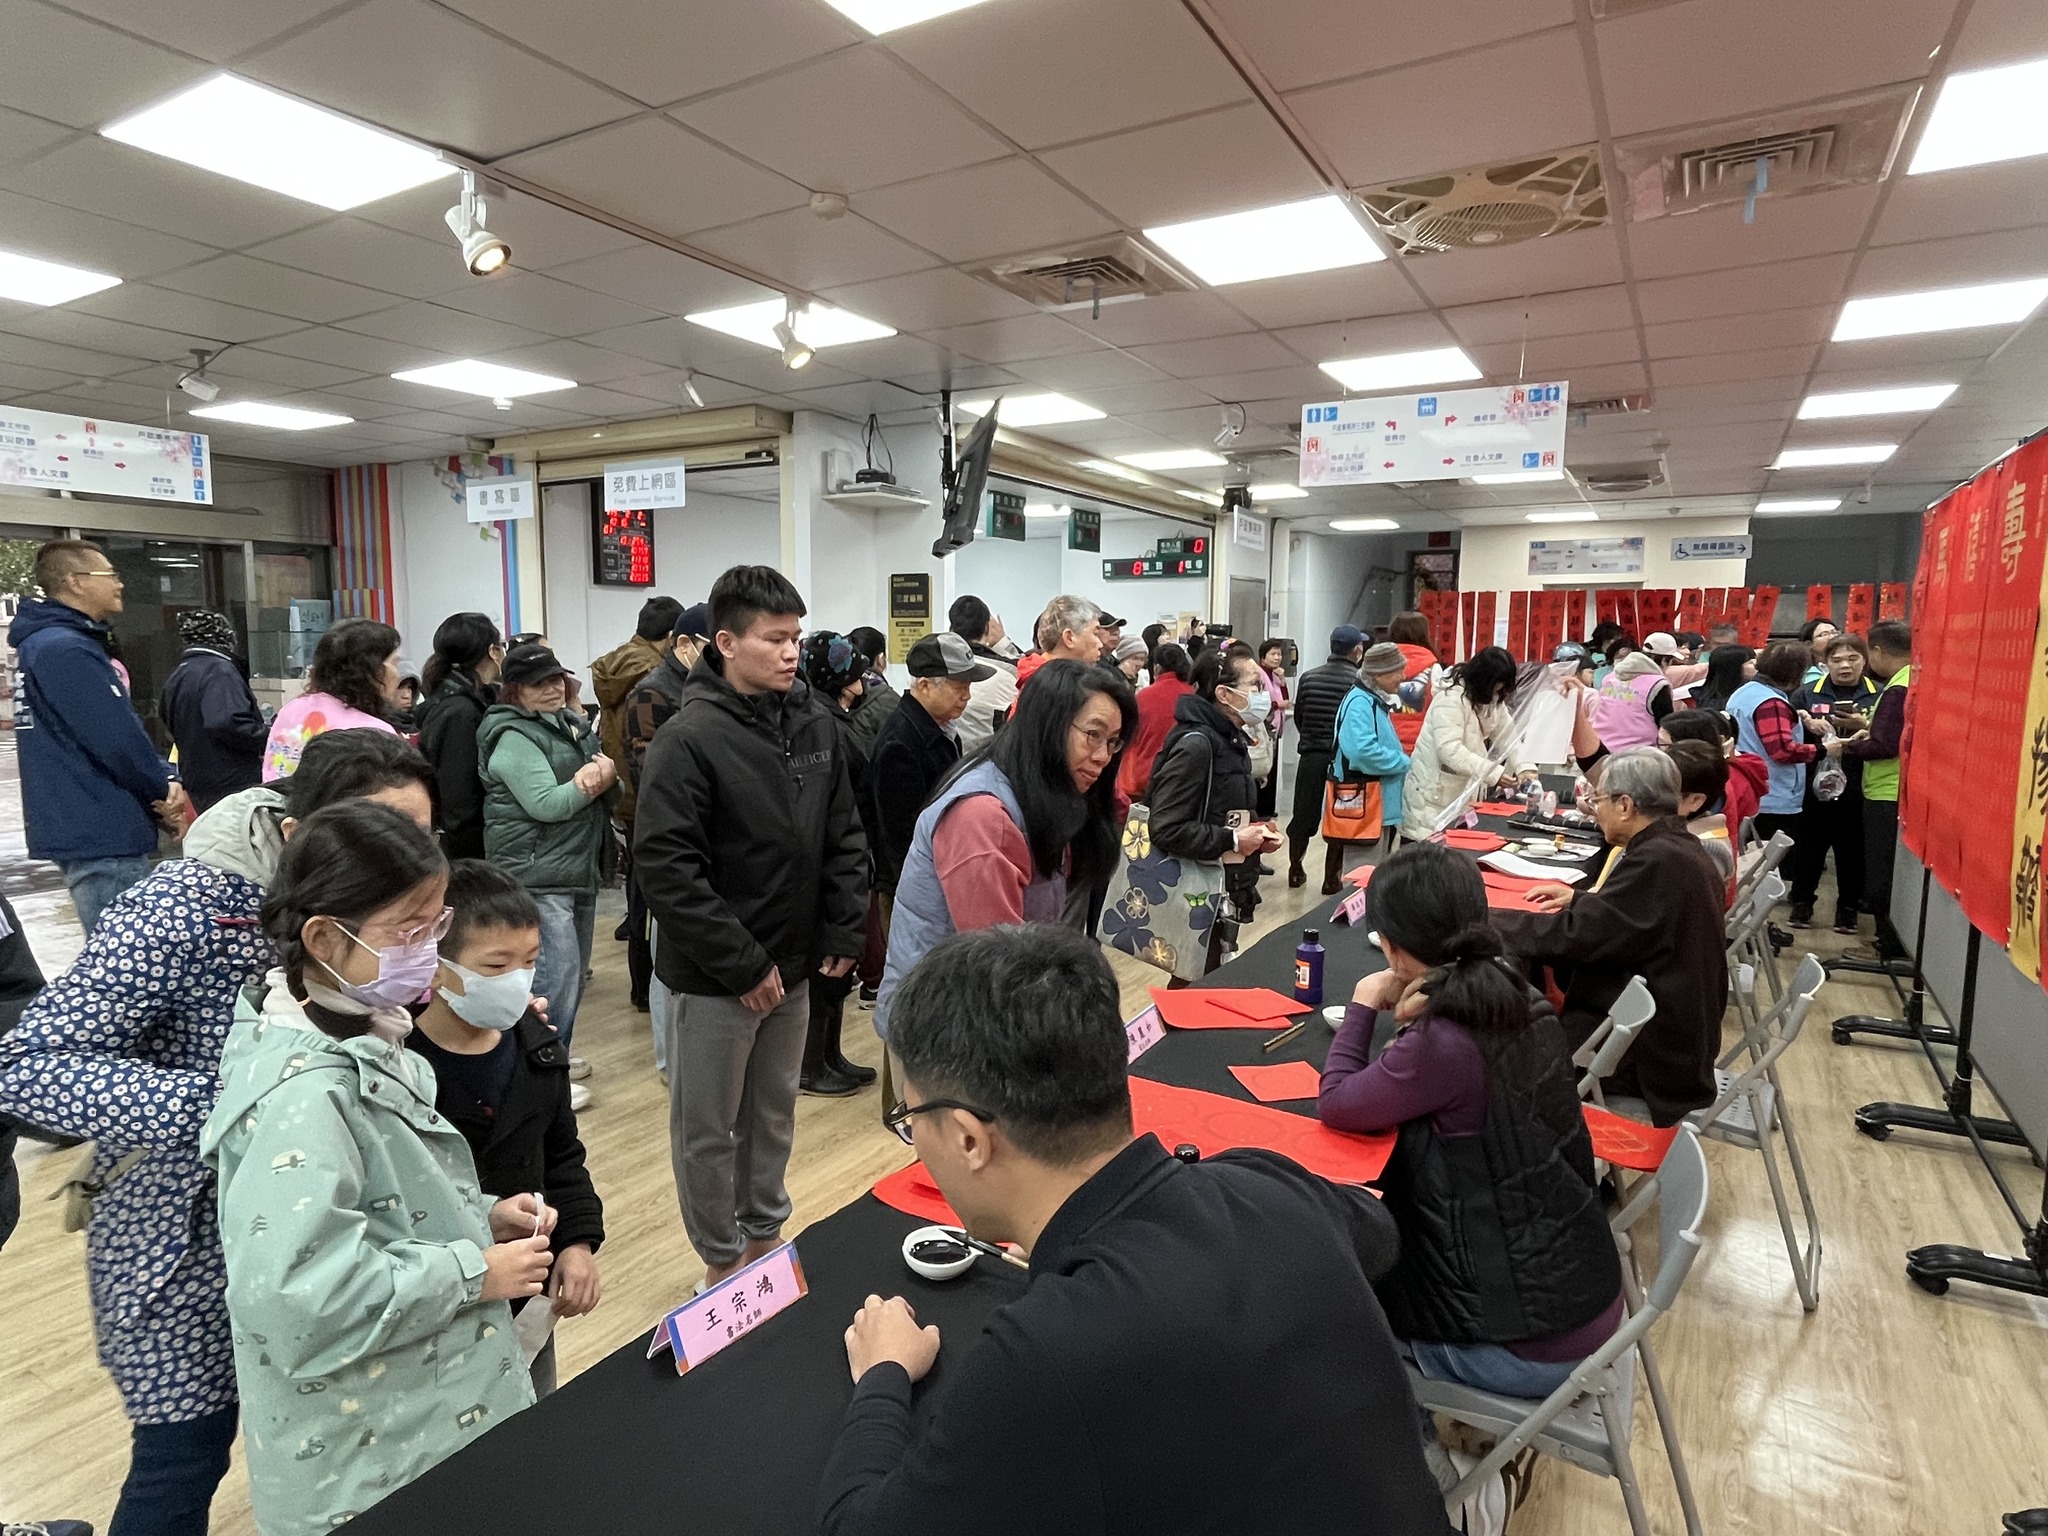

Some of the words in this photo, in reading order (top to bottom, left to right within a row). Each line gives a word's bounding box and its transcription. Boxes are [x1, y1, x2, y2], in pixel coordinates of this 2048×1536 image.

[613, 472, 676, 493] 免費上網區
[479, 487, 520, 506] 書寫區
[1133, 561, 1143, 575] 8
[705, 1274, 774, 1332] 王宗鴻
[726, 1308, 763, 1339] 書法名師
